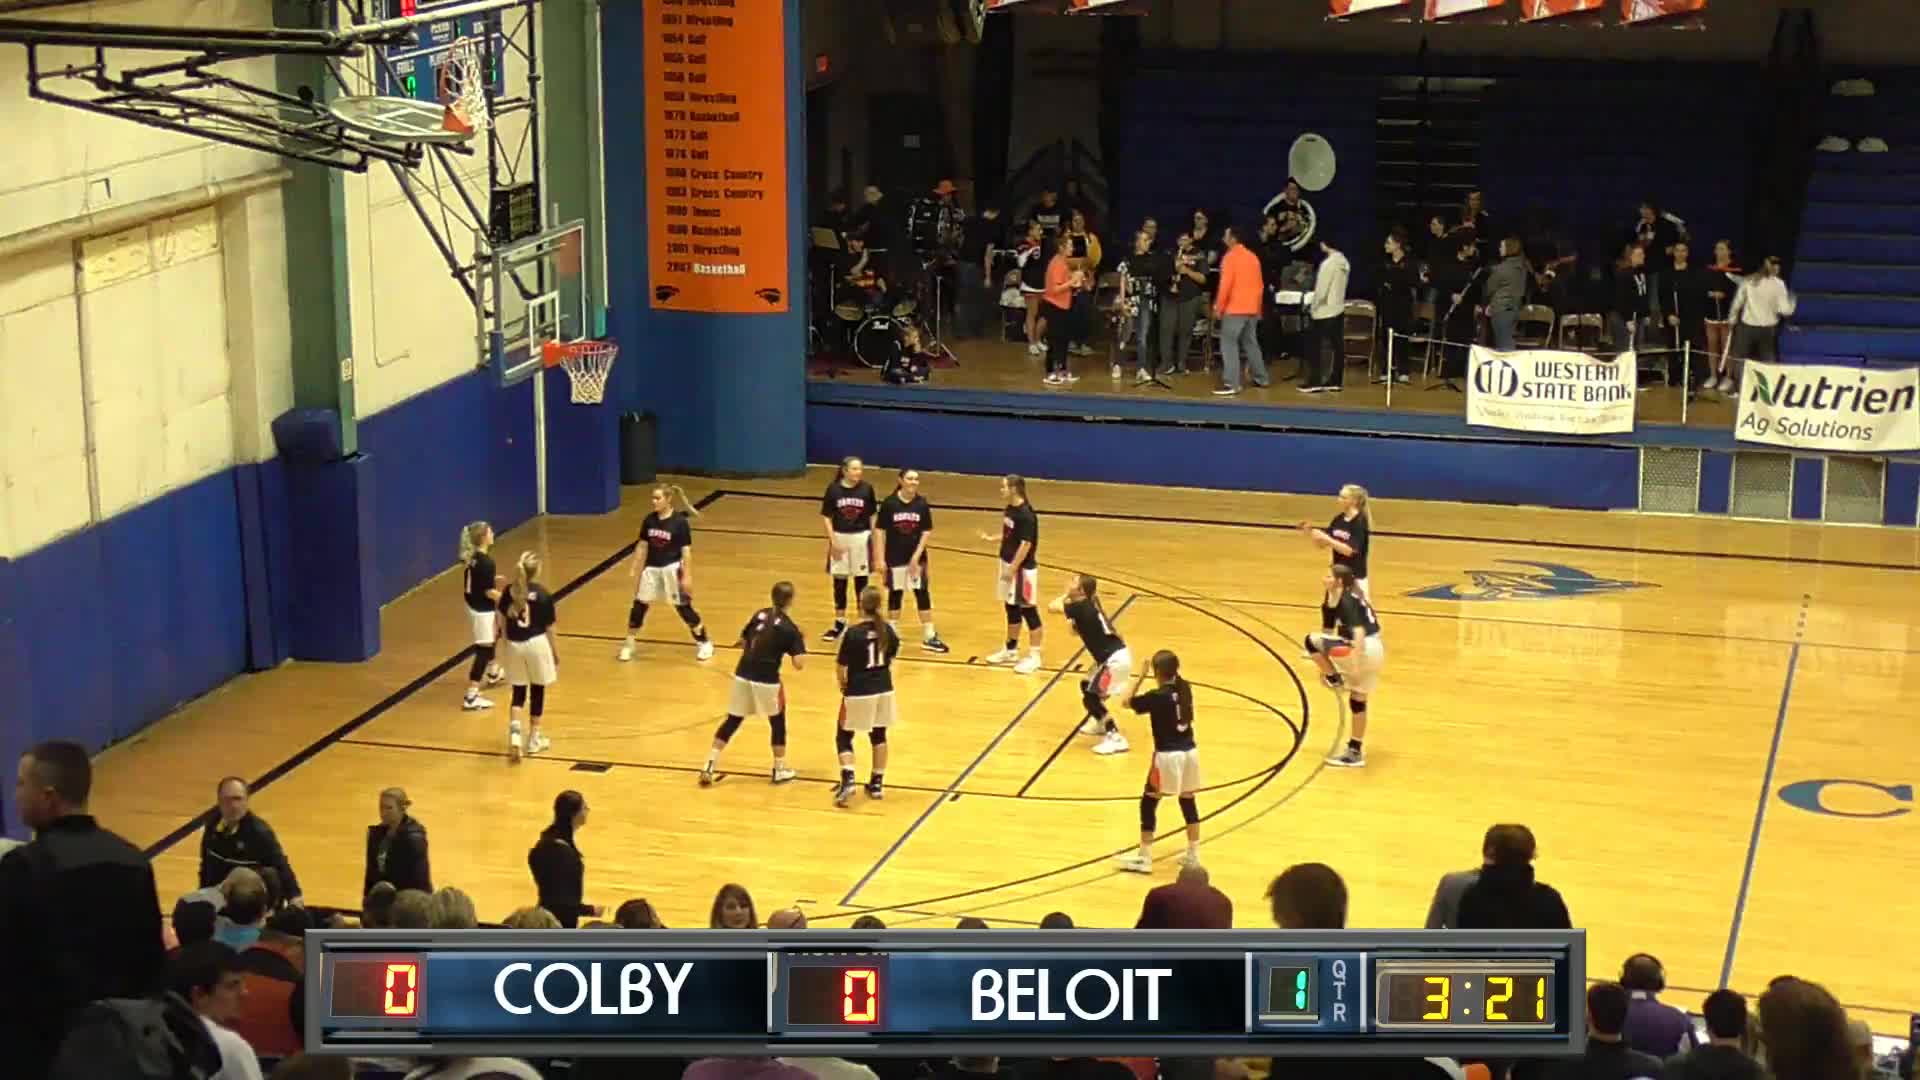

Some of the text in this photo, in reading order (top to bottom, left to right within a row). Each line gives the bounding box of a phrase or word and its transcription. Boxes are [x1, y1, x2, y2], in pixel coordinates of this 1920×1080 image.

[690, 111, 740, 122] Basketball
[691, 169, 719, 180] Cross
[724, 169, 764, 181] Country
[691, 187, 719, 198] Cross
[724, 188, 764, 200] Country
[692, 225, 741, 236] Basketball
[692, 244, 740, 256] Wrestling
[694, 263, 746, 275] Basketball
[1535, 361, 1620, 382] WESTERN
[1521, 381, 1632, 403] STATE BANK
[1750, 369, 1916, 415] Nutrien
[1740, 411, 1873, 442] Ag Solutions
[1777, 778, 1913, 819] C
